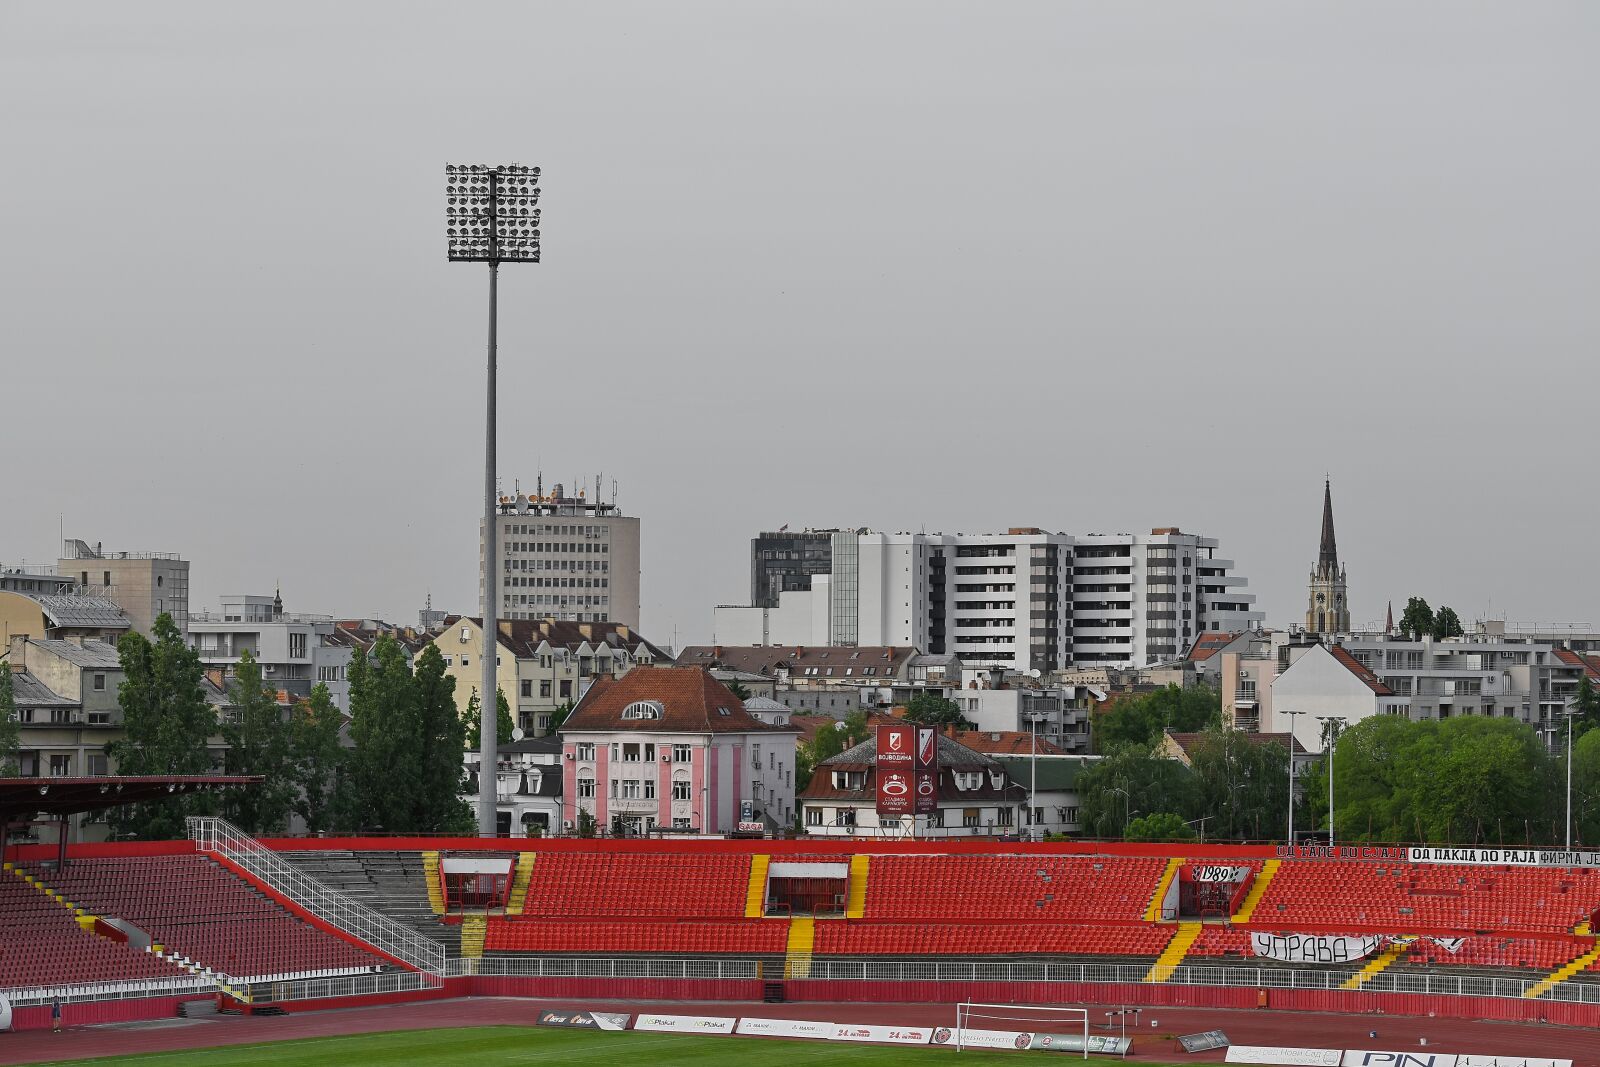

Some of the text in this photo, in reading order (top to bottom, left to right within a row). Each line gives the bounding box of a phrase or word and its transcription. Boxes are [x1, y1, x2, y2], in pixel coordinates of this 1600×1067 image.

[1277, 846, 1408, 860] ОД ТАМЕ ДО СЈАЈА
[1412, 848, 1537, 864] ОД ПАКЛА ДО РАЈА
[1540, 852, 1582, 865] ФИРМА
[1201, 866, 1229, 883] 1989
[1258, 935, 1348, 962] УПРАВА
[1361, 1052, 1436, 1067] PIN
